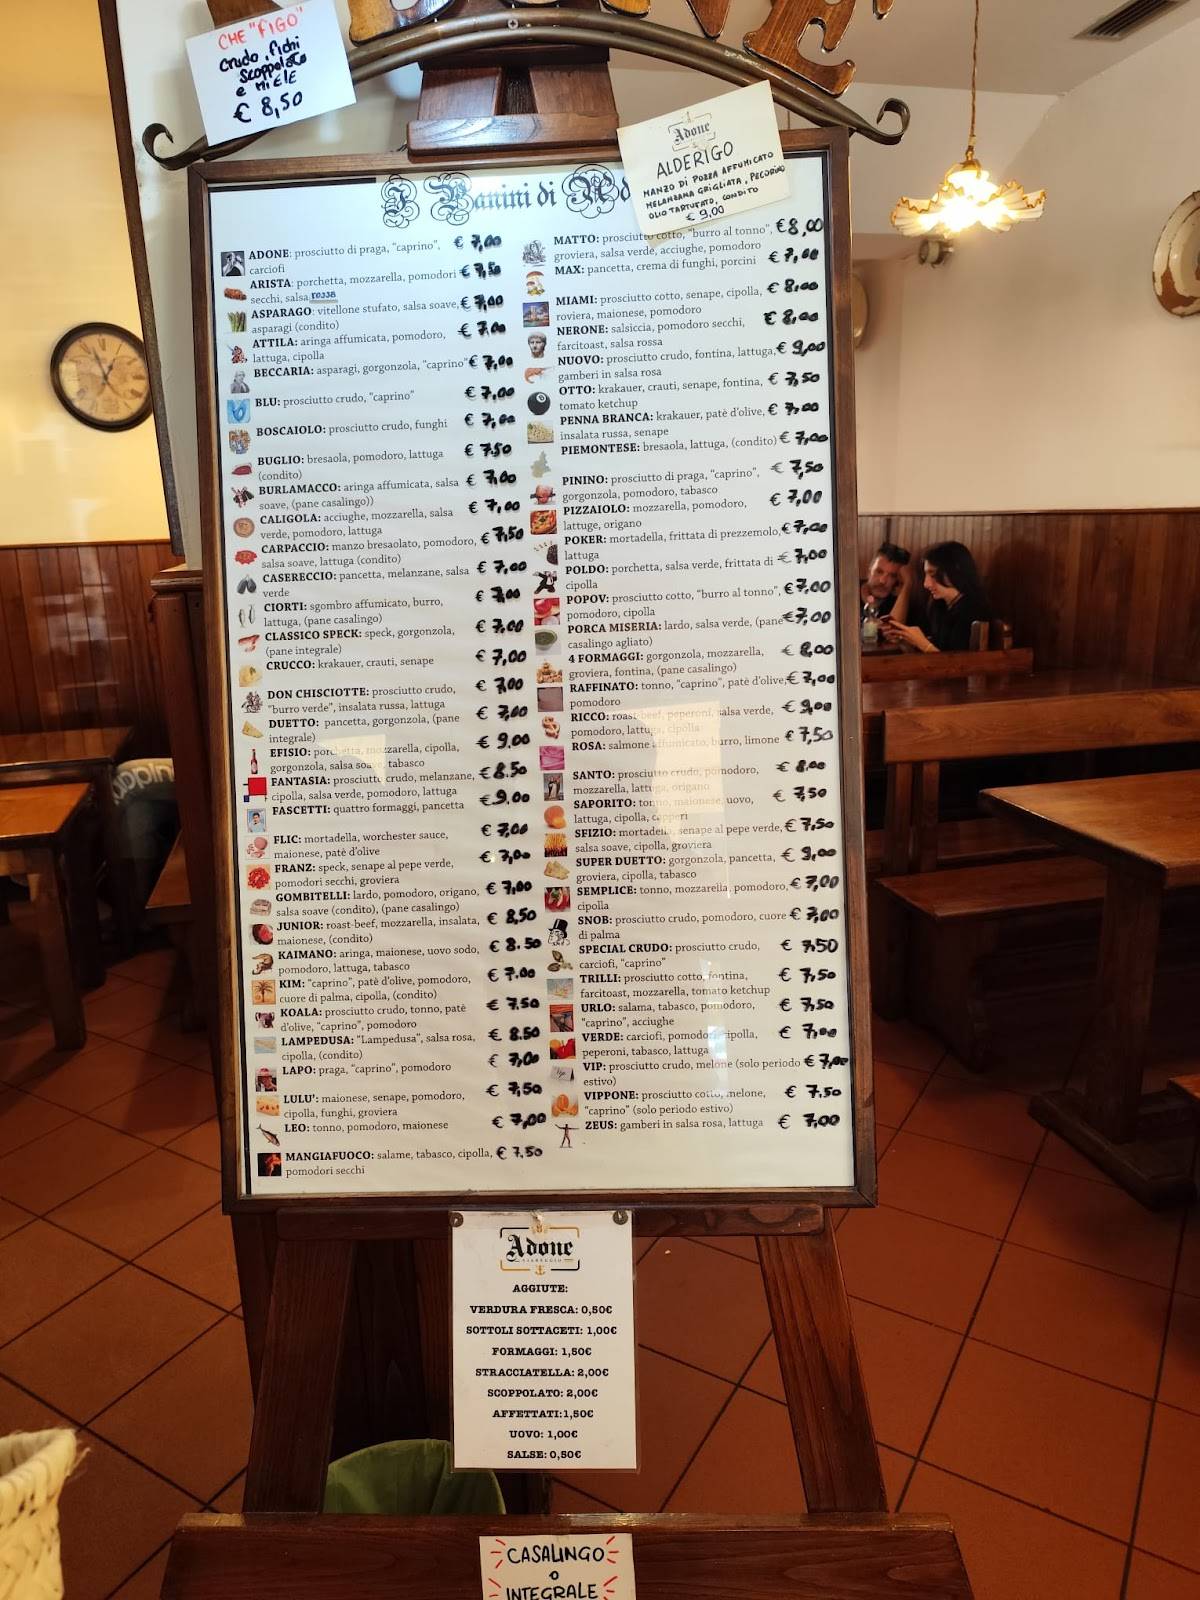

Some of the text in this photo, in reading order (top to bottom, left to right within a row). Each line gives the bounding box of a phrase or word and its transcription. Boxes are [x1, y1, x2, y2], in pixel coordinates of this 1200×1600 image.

[218, 30, 247, 50] CHE
[236, 86, 246, 96] e
[233, 91, 302, 122] € 8,50
[673, 122, 710, 145] Adone
[656, 141, 734, 179] ALDERIGO
[643, 185, 675, 198] MANZO
[693, 171, 719, 183] POZZA
[722, 152, 774, 175] AFFUMICATO
[537, 181, 557, 207] di
[646, 191, 695, 209] MELANZANA
[649, 210, 667, 219] OLIO
[553, 233, 599, 245] MATTO:
[247, 248, 292, 260] ADONE:
[554, 264, 585, 275] MAX:
[249, 278, 294, 289] ARISTA:
[555, 294, 598, 306] MIAMI:
[250, 306, 315, 319] ASPARAGO:
[555, 323, 609, 336] NERONE:
[252, 337, 298, 349] ATTILA:
[557, 354, 604, 366] NUOVO:
[253, 365, 314, 378] BECCARIA:
[558, 376, 763, 396] OTTO: krakauer, crauti, senape, fontina,
[254, 396, 280, 407] BLU:
[559, 411, 654, 426] PENNA BRANCA:
[255, 424, 326, 437] BOSCAIOLO:
[560, 441, 640, 455] PIEMONTESE:
[256, 455, 304, 466] BUGLIO:
[561, 474, 608, 486] PININO:
[258, 482, 341, 495] BURLAMACCO:
[258, 502, 289, 510] soave,
[290, 498, 319, 511] (pane
[562, 503, 630, 516] PIZZAIOLO:
[259, 513, 321, 524] CALIGOLA:
[563, 534, 607, 545] POKER:
[260, 542, 329, 554] CARPACCIO:
[564, 563, 609, 575] POLDO:
[262, 570, 337, 583] CASERECCIO:
[565, 593, 609, 605] POPOV:
[263, 601, 307, 612] CIORTI:
[567, 621, 662, 634] PORCA MISERIA:
[264, 628, 362, 642] CLASSICO SPECK:
[568, 651, 643, 664] 4 FORMAGGI:
[265, 657, 315, 671] CRUCCO:
[569, 681, 638, 693] RAFFINATO:
[266, 687, 369, 700] DON CHISCIOTTE:
[570, 710, 609, 722] RICCO:
[268, 717, 319, 729] DUETTO:
[571, 740, 606, 751] ROSA:
[269, 747, 311, 758] EFISIO:
[270, 775, 330, 787] FANTASIA:
[572, 769, 615, 781] SANTO:
[271, 804, 331, 815] FASCETTI:
[573, 798, 636, 809] SAPORITO:
[574, 827, 617, 838] SFIZIO:
[273, 834, 302, 845] FLIC:
[575, 855, 666, 867] SUPER DUETTO:
[273, 862, 316, 873] FRANZ:
[275, 890, 351, 902] GOMBITELLI:
[576, 884, 637, 896] SEMPLICE:
[276, 920, 323, 931] JUNIOR:
[577, 914, 613, 926] SNOB:
[277, 948, 337, 960] KAIMANO:
[578, 942, 672, 955] SPECIAL CRUDO:
[278, 978, 305, 989] KIM:
[578, 973, 621, 984] TRILLI:
[279, 1007, 322, 1018] KOALA:
[324, 1006, 375, 1019] prosciutto
[376, 1003, 407, 1015] crudo,
[410, 1005, 442, 1014] tonno,
[580, 1001, 616, 1013] URLO:
[280, 1035, 354, 1046] LAMPEDUSA:
[581, 1031, 624, 1042] VERDE:
[281, 1065, 316, 1075] LAPO:
[582, 1061, 606, 1071] VIP:
[583, 1090, 639, 1101] VIPPONE:
[283, 1123, 310, 1133] LEO:
[584, 1117, 763, 1132] ZEUS: gamberi in salsa rosa, lattuga
[284, 1150, 374, 1161] MANGIAFUOCO:
[506, 1234, 573, 1263] Adone
[513, 1285, 568, 1293] AGGIUTE:
[470, 1305, 613, 1315] VERDURA FRESCA: 0,50€
[466, 1326, 617, 1335] SOTTOLI SOTTACETI: 1,00€
[492, 1347, 592, 1357] FORMAGGI: 1,50€
[475, 1368, 609, 1377] STRACCIATELLA: 2,00€
[487, 1389, 598, 1398] SCOPPOLATO: 2,00€
[509, 1430, 578, 1439] UOVO: 1,00€
[507, 1450, 582, 1460] SALSE: 0,50€
[507, 1544, 604, 1564] CASALINGO
[507, 1582, 598, 1600] INTEGRALE
